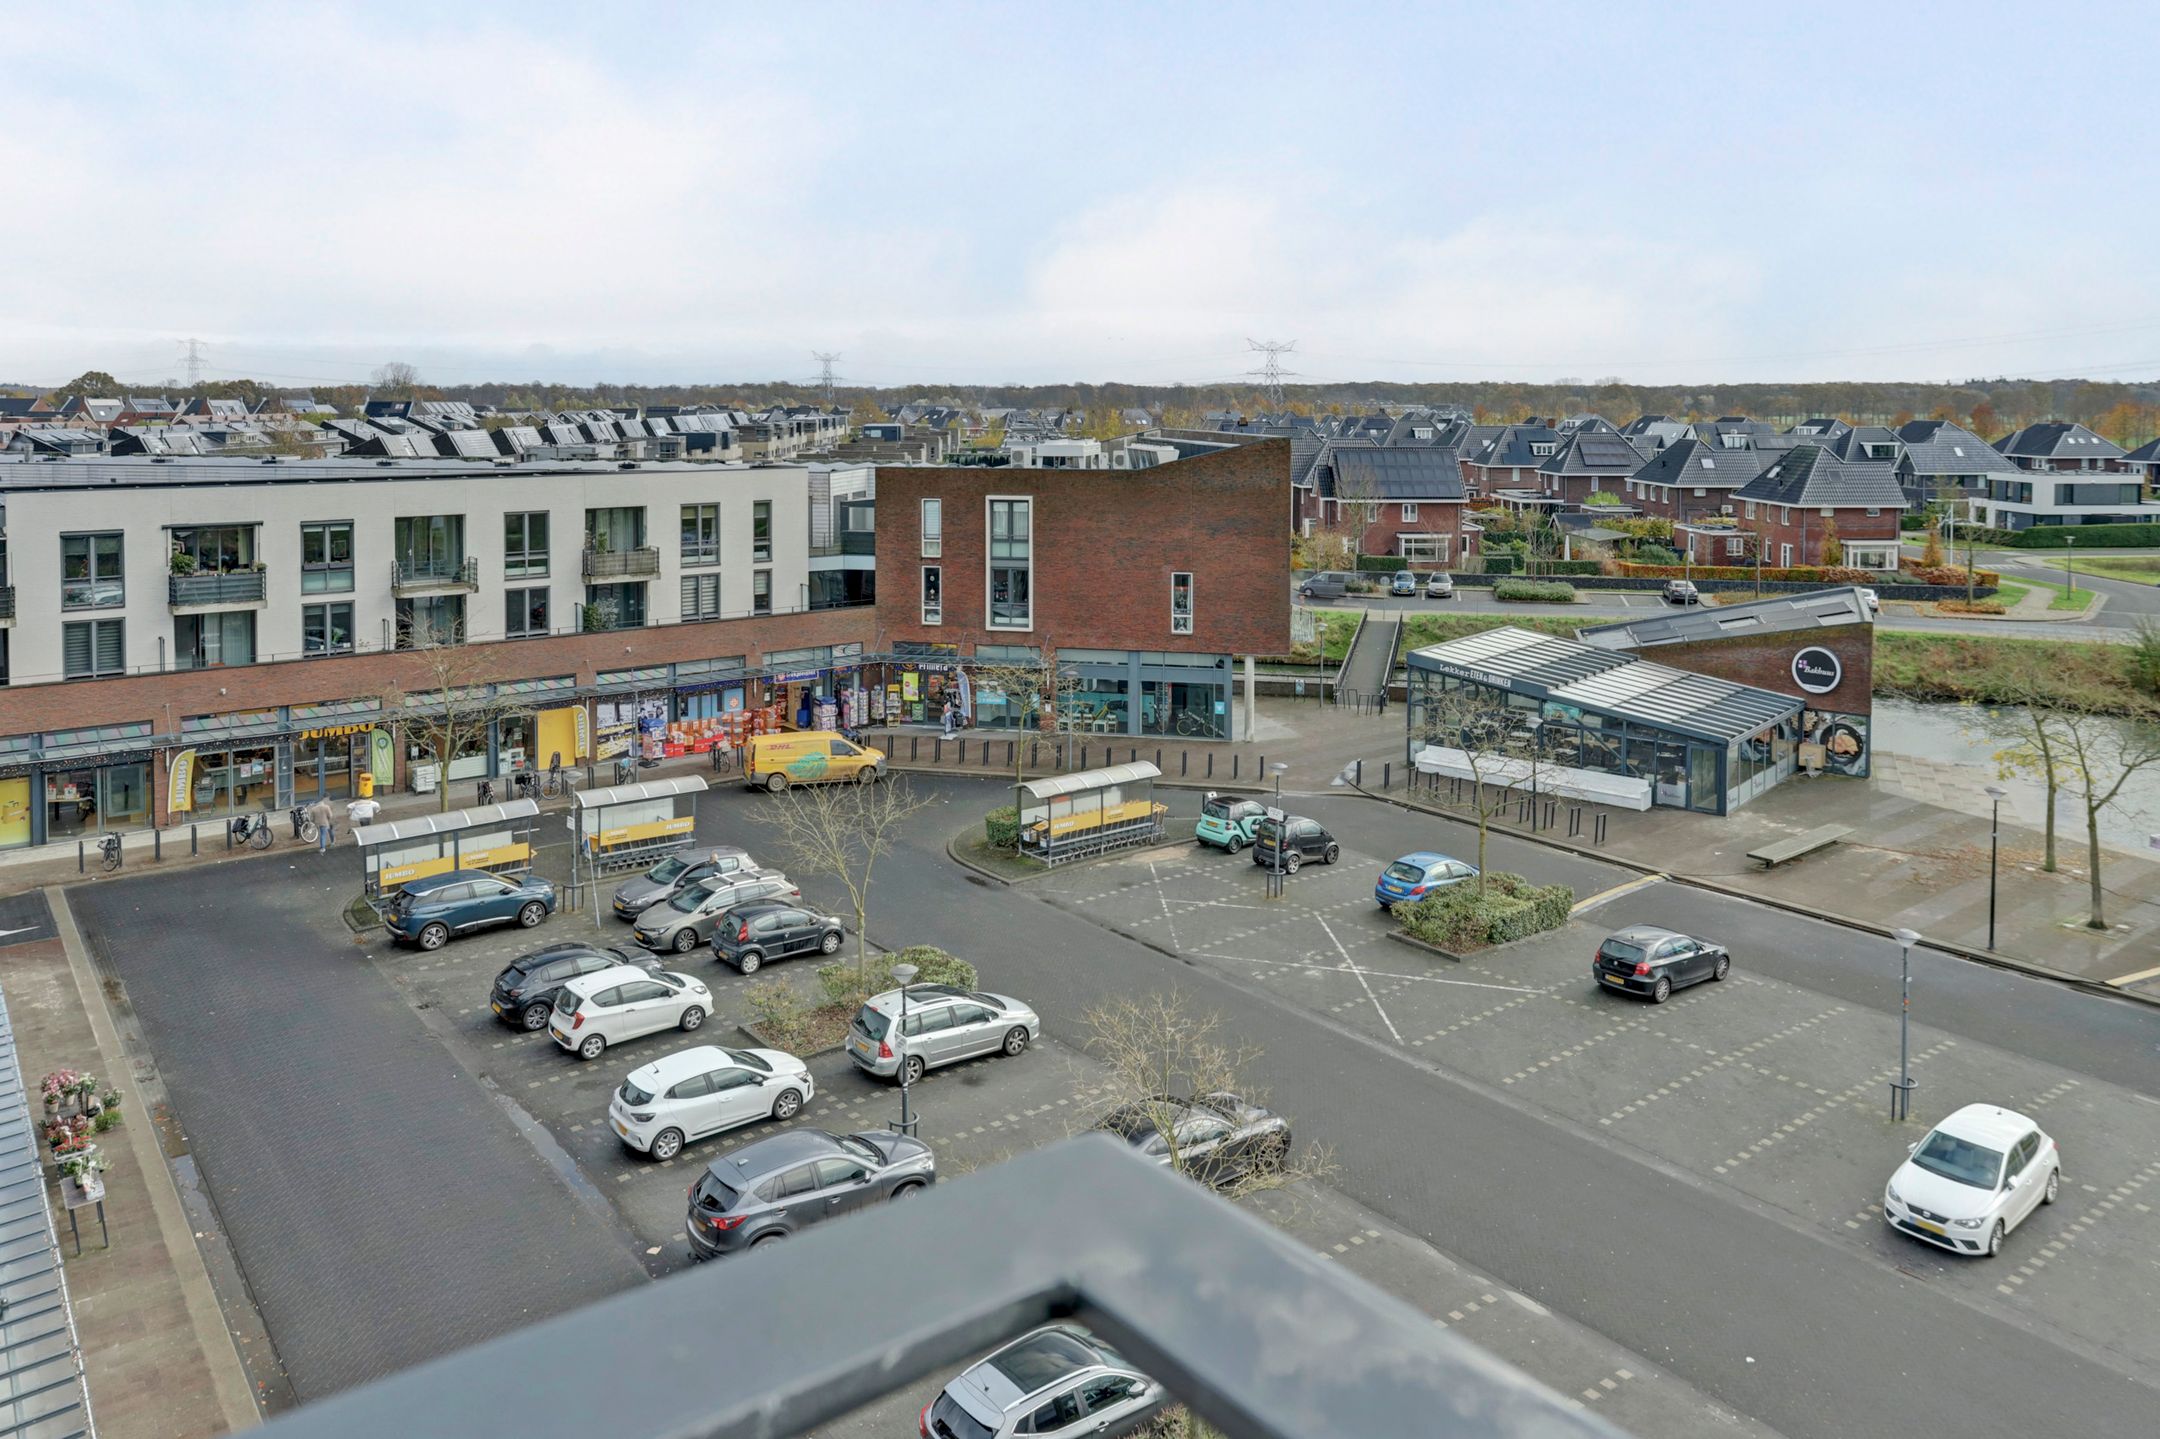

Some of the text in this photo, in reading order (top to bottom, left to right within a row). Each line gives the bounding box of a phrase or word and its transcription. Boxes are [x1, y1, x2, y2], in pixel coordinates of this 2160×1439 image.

[1439, 663, 1470, 677] Lekker
[1470, 669, 1483, 681] ETEN
[175, 759, 187, 803] JUMBO
[385, 868, 415, 881] JUMBO
